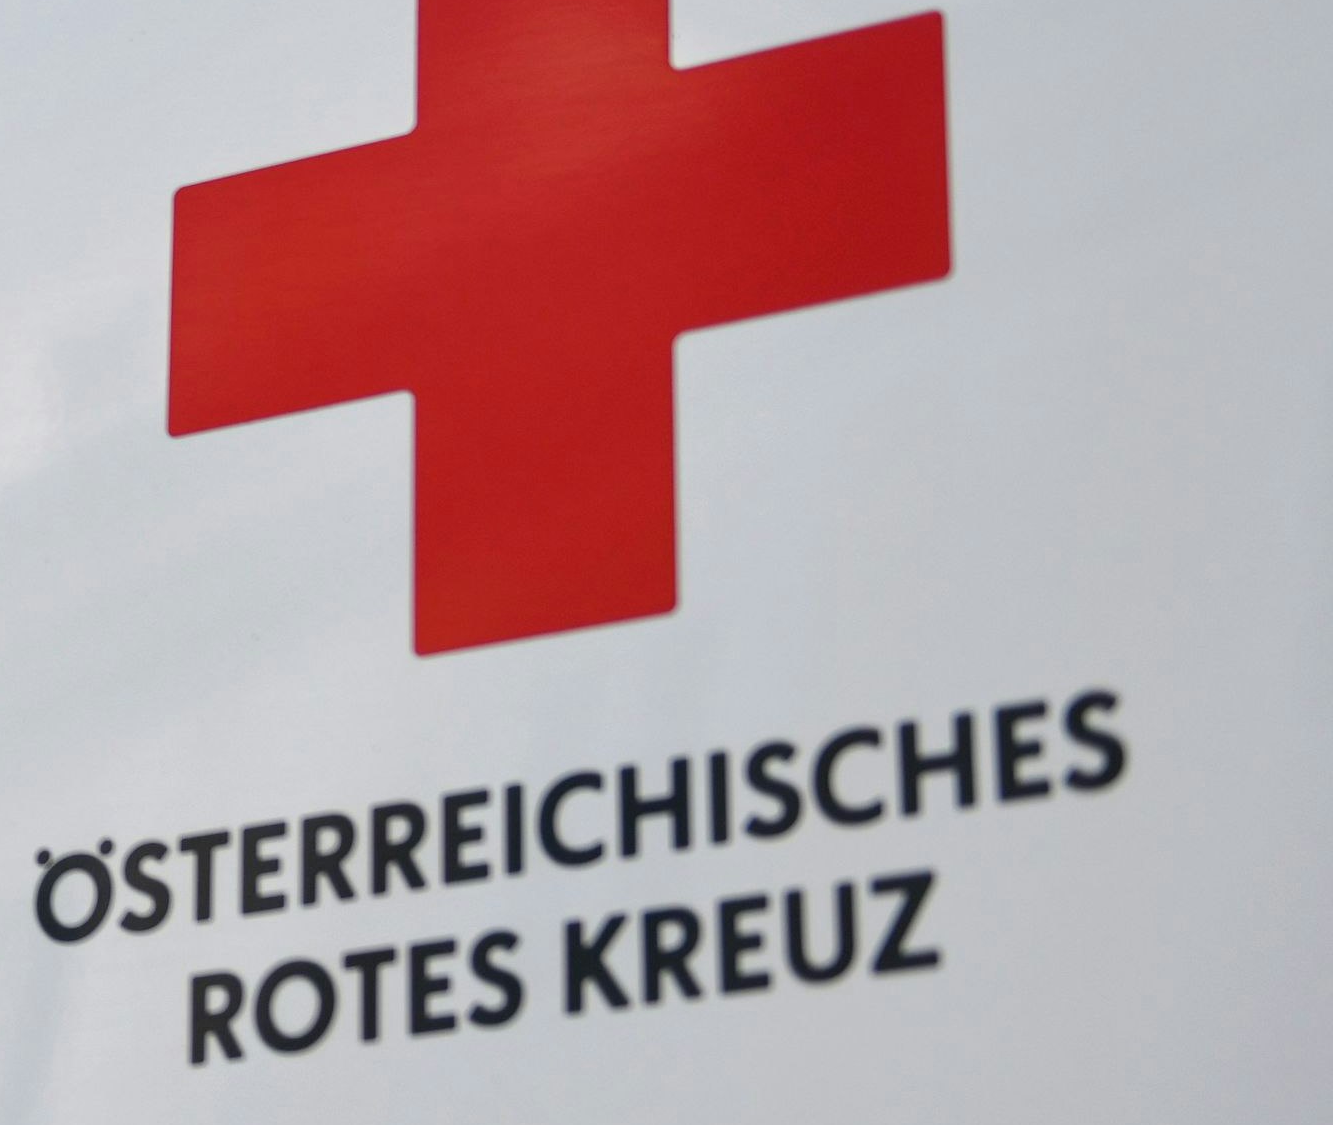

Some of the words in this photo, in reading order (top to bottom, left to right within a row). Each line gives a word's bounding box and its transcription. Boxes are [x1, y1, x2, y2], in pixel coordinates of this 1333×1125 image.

[33, 688, 1129, 945] ÖSTERREICHISCHES
[188, 928, 526, 1067] ROTES
[562, 868, 943, 1017] KREUZ
